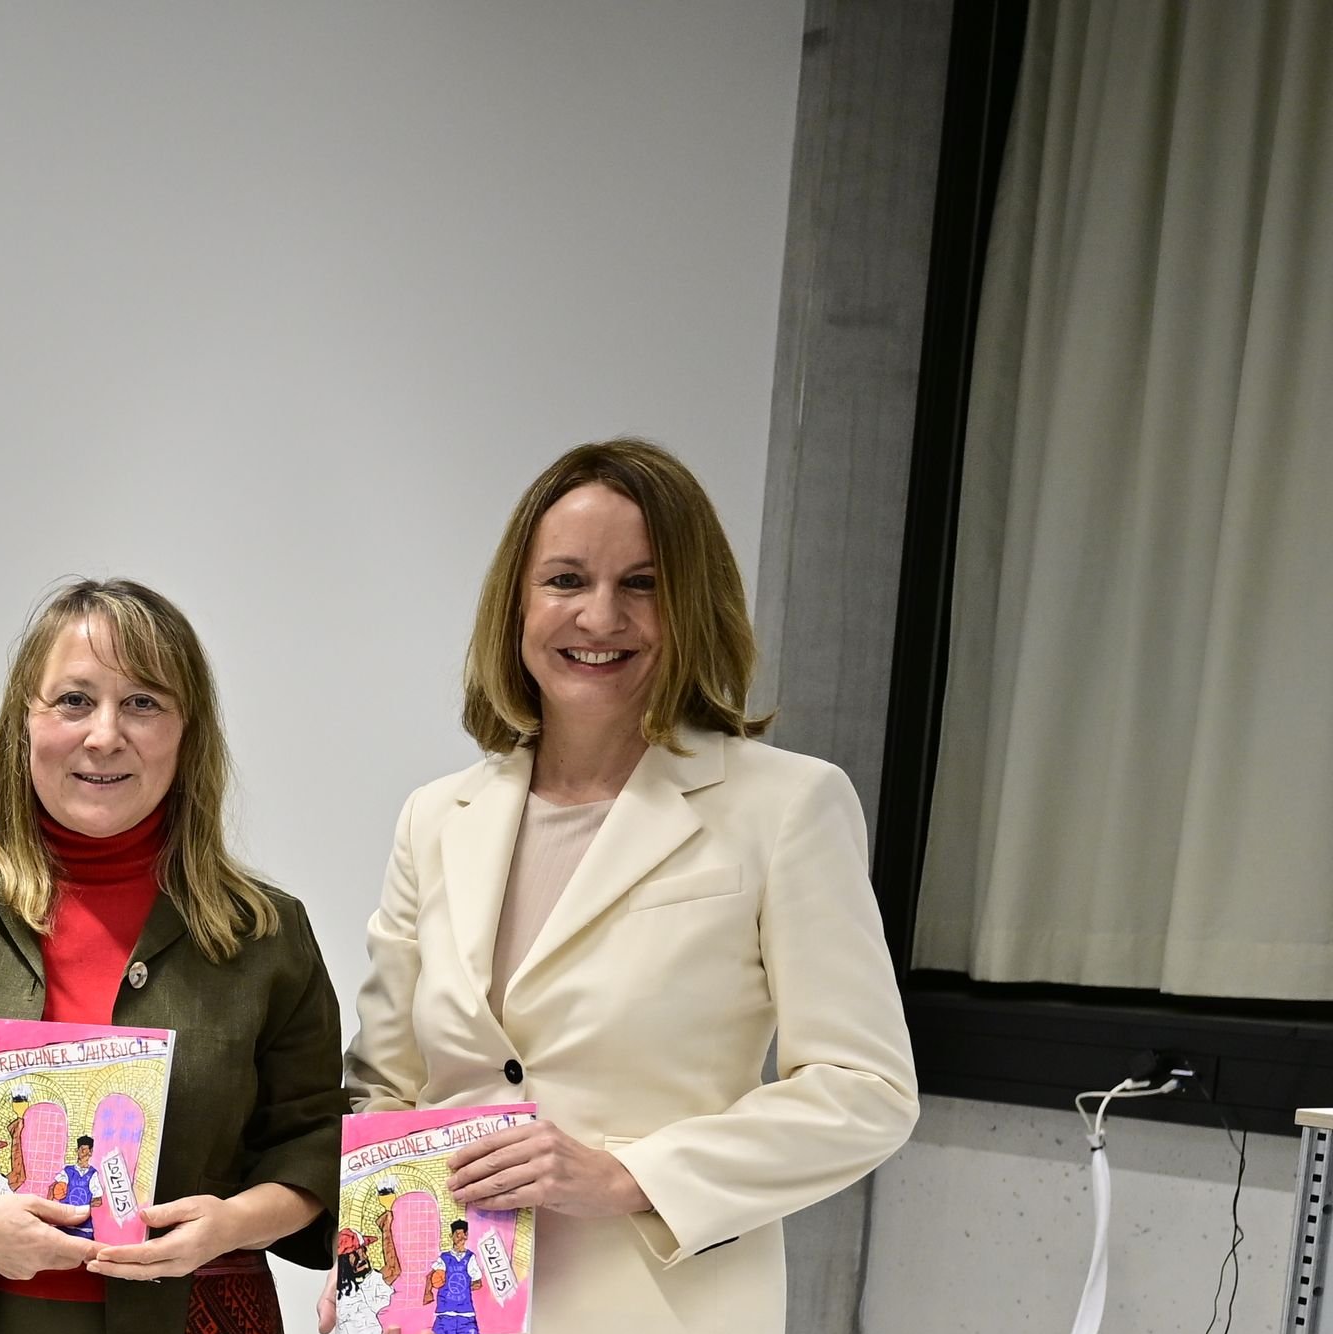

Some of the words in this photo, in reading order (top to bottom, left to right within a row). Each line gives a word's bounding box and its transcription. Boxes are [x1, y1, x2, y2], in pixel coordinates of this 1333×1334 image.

[77, 1040, 150, 1062] JAHRBUCH
[347, 1135, 438, 1172] GRENCHNER
[107, 1157, 132, 1212] 2024/25
[484, 1237, 511, 1292] 2024/25
